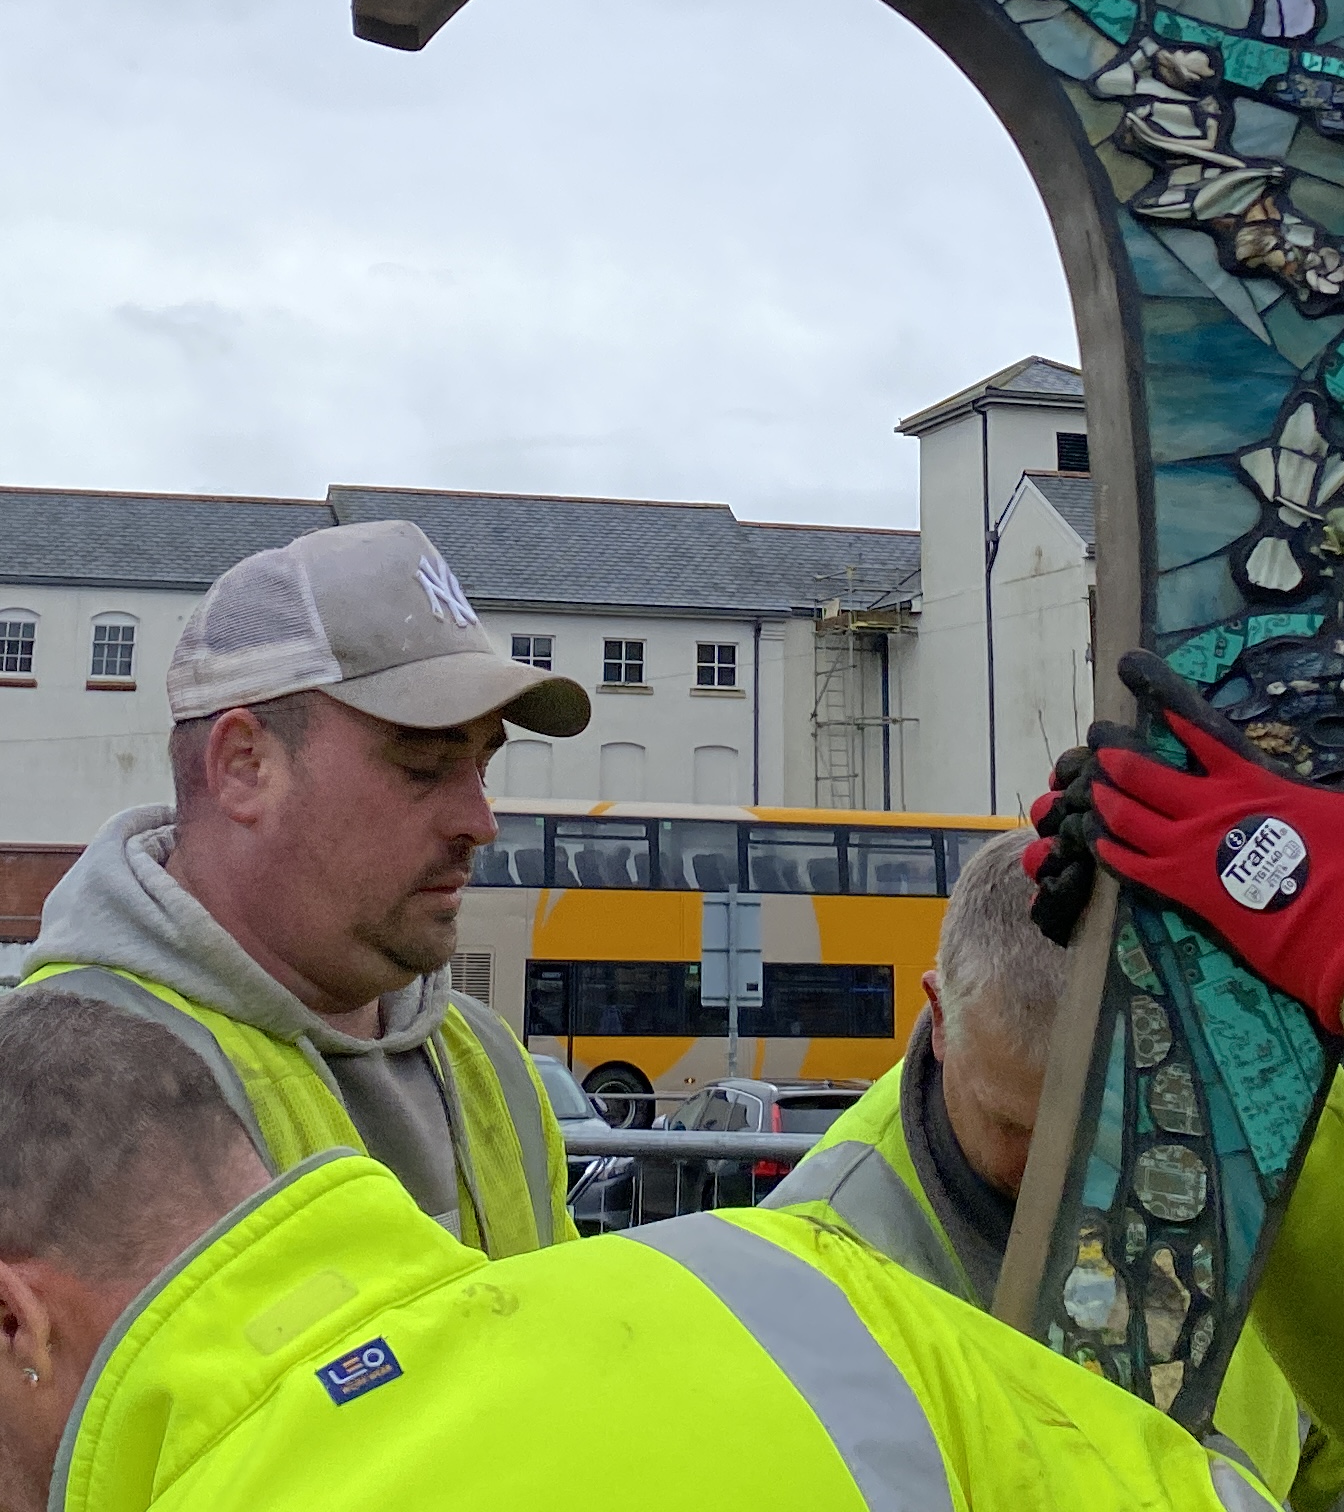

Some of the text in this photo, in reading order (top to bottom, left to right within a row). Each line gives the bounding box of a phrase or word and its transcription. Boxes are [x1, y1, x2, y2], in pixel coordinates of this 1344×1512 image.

[1225, 824, 1282, 884] Traffi
[1252, 850, 1283, 884] TG1140
[328, 1348, 385, 1385] LEO
